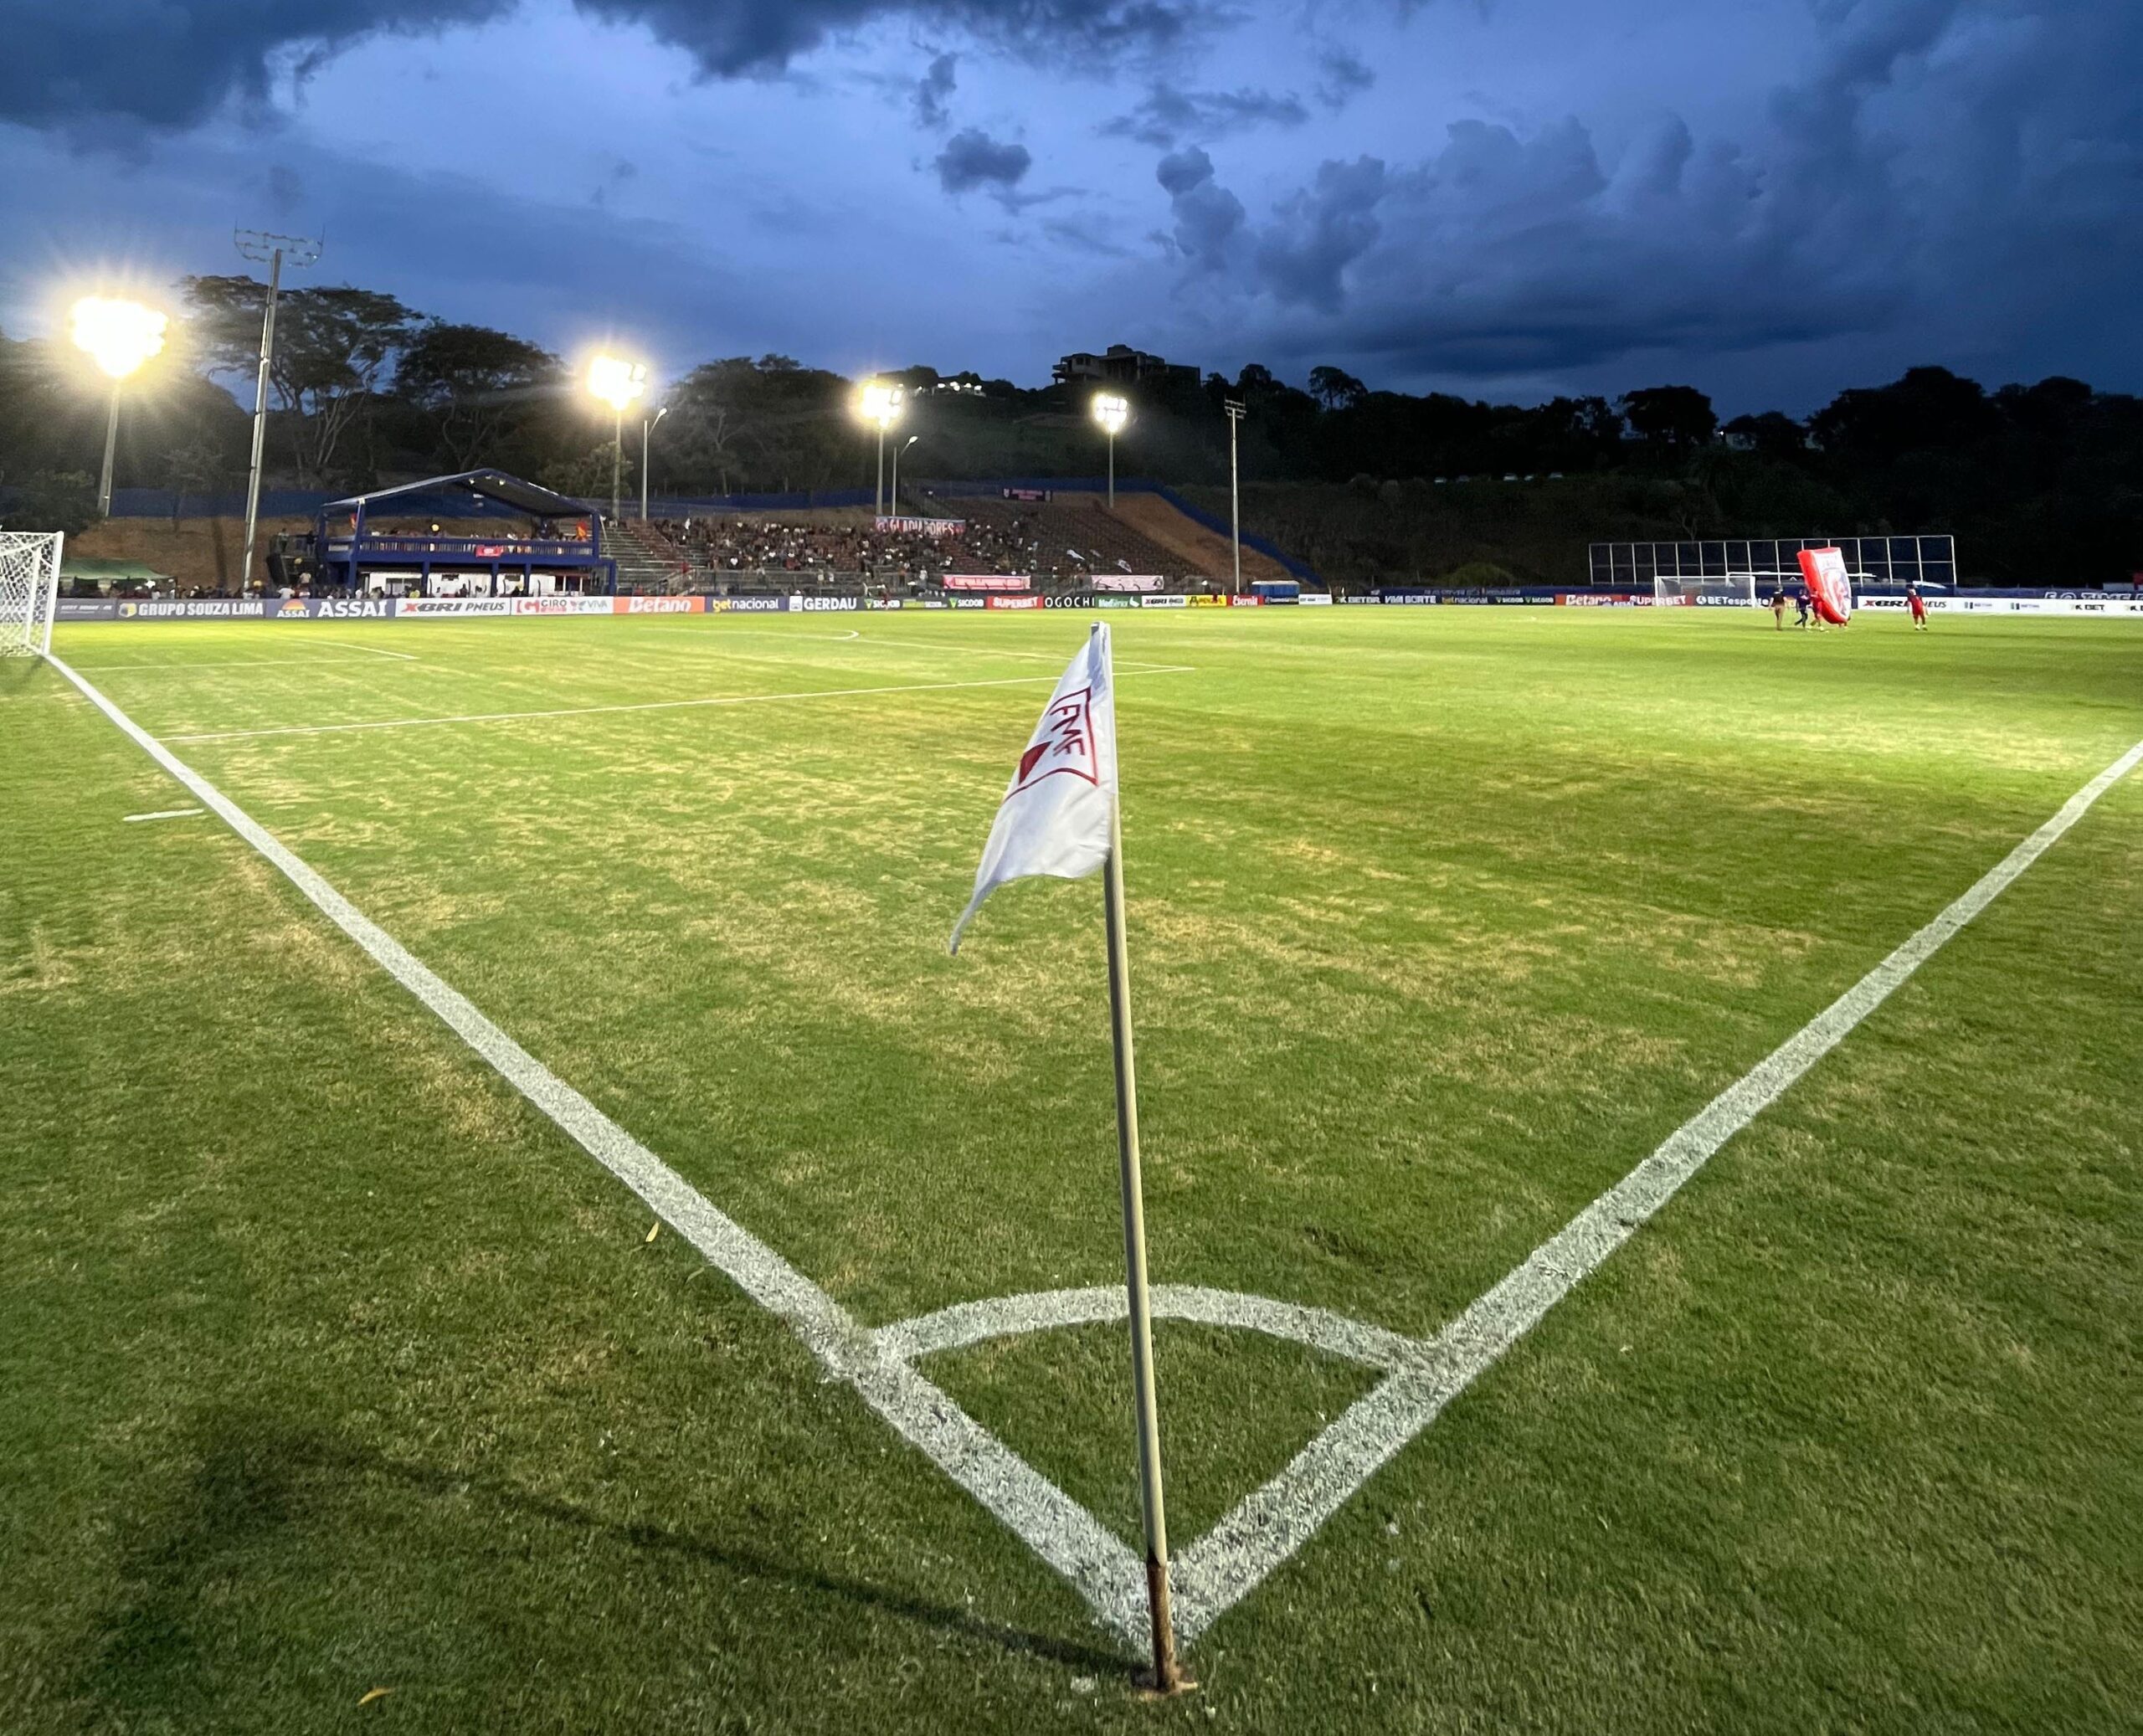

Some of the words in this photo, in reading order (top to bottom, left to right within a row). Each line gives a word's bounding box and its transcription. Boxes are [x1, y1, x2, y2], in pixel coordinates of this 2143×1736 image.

[402, 603, 462, 612] XBRI
[465, 602, 506, 612] PNEUS
[630, 596, 692, 613] Betano
[804, 597, 857, 610] GERDAU
[1044, 596, 1095, 608] OGOCHI
[138, 603, 182, 616] GRUPO
[187, 603, 230, 615] SOUZA
[232, 602, 264, 615] LIMA
